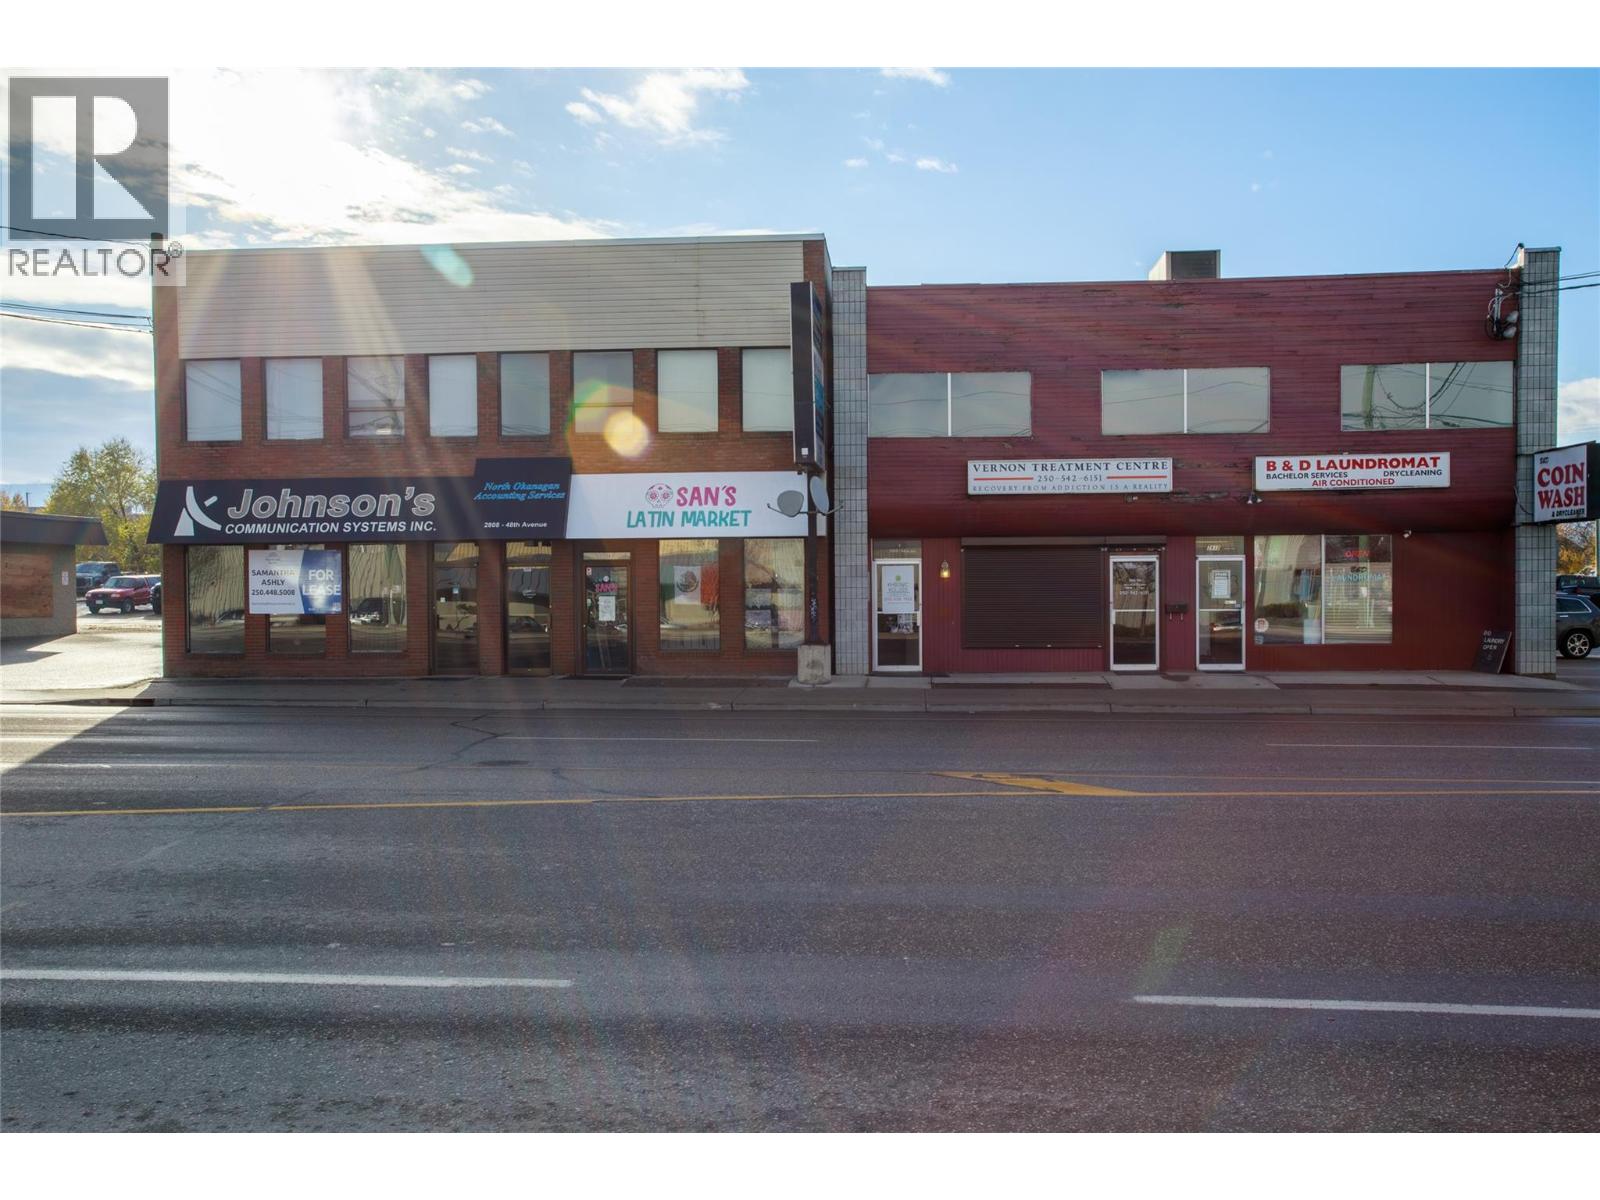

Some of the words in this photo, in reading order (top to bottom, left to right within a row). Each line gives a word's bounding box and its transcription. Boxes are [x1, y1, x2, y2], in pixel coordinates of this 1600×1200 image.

[973, 463, 1026, 473] VERNON
[1032, 461, 1111, 472] TREATMENT
[1116, 461, 1169, 471] CENTRE
[1266, 460, 1277, 472] B
[1281, 460, 1294, 472] &
[1299, 459, 1311, 471] D
[1316, 456, 1441, 471] LAUNDROMAT
[1266, 472, 1309, 480] BACHELOR
[1311, 471, 1348, 479] SERVICES
[1383, 469, 1443, 477] DRYCLEANING
[1537, 462, 1585, 487] COIN
[483, 481, 511, 491] North
[513, 481, 560, 492] Okanagan
[973, 484, 1018, 492] RECOVERY
[1311, 479, 1328, 487] AIR
[1330, 478, 1395, 486] CONDITIONED
[473, 491, 527, 501] Accounting
[527, 490, 566, 499] Services
[1537, 485, 1585, 510] WASH
[226, 486, 436, 519] Johnson's
[626, 510, 675, 528] LATIN
[680, 509, 753, 528] MARKET
[225, 522, 342, 535] COMMUNICATION
[342, 521, 406, 533] SYSTEMS
[409, 520, 437, 532] INC.
[308, 569, 334, 581] FOR
[261, 578, 286, 586] ASHLY
[302, 584, 341, 596] LEASE
